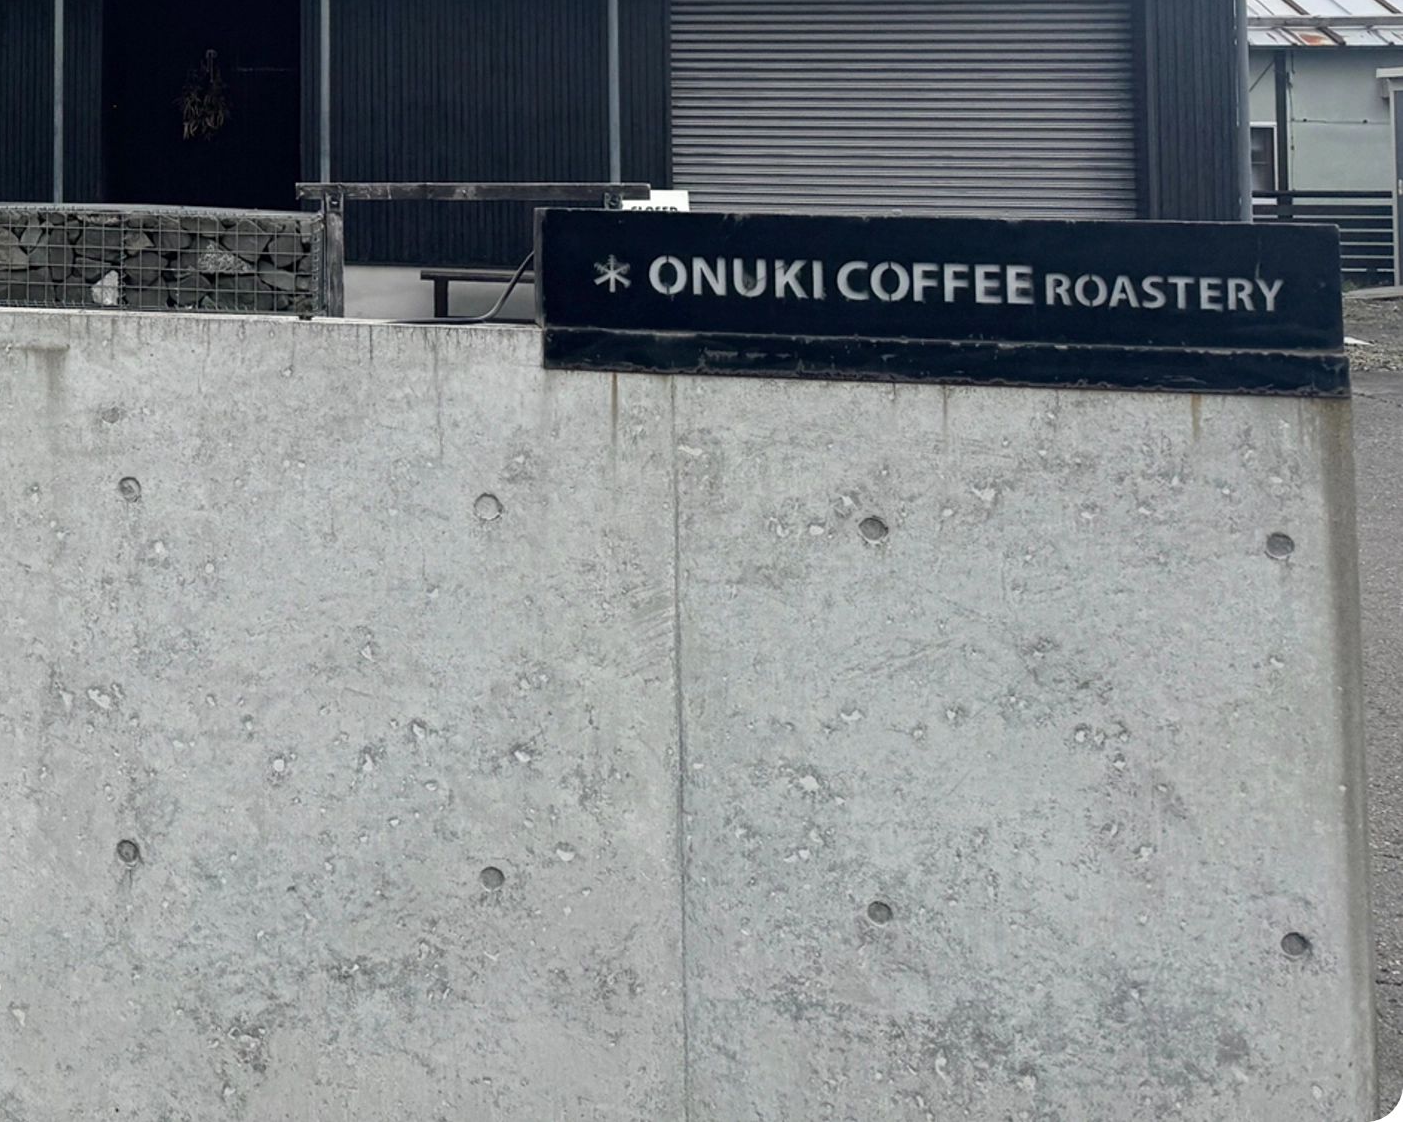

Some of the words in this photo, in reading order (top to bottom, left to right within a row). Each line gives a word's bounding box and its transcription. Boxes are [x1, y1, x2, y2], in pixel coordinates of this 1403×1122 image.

[648, 255, 826, 300] ONUKI
[836, 260, 1034, 305] COFFEE
[1045, 273, 1284, 312] ROASTERY
